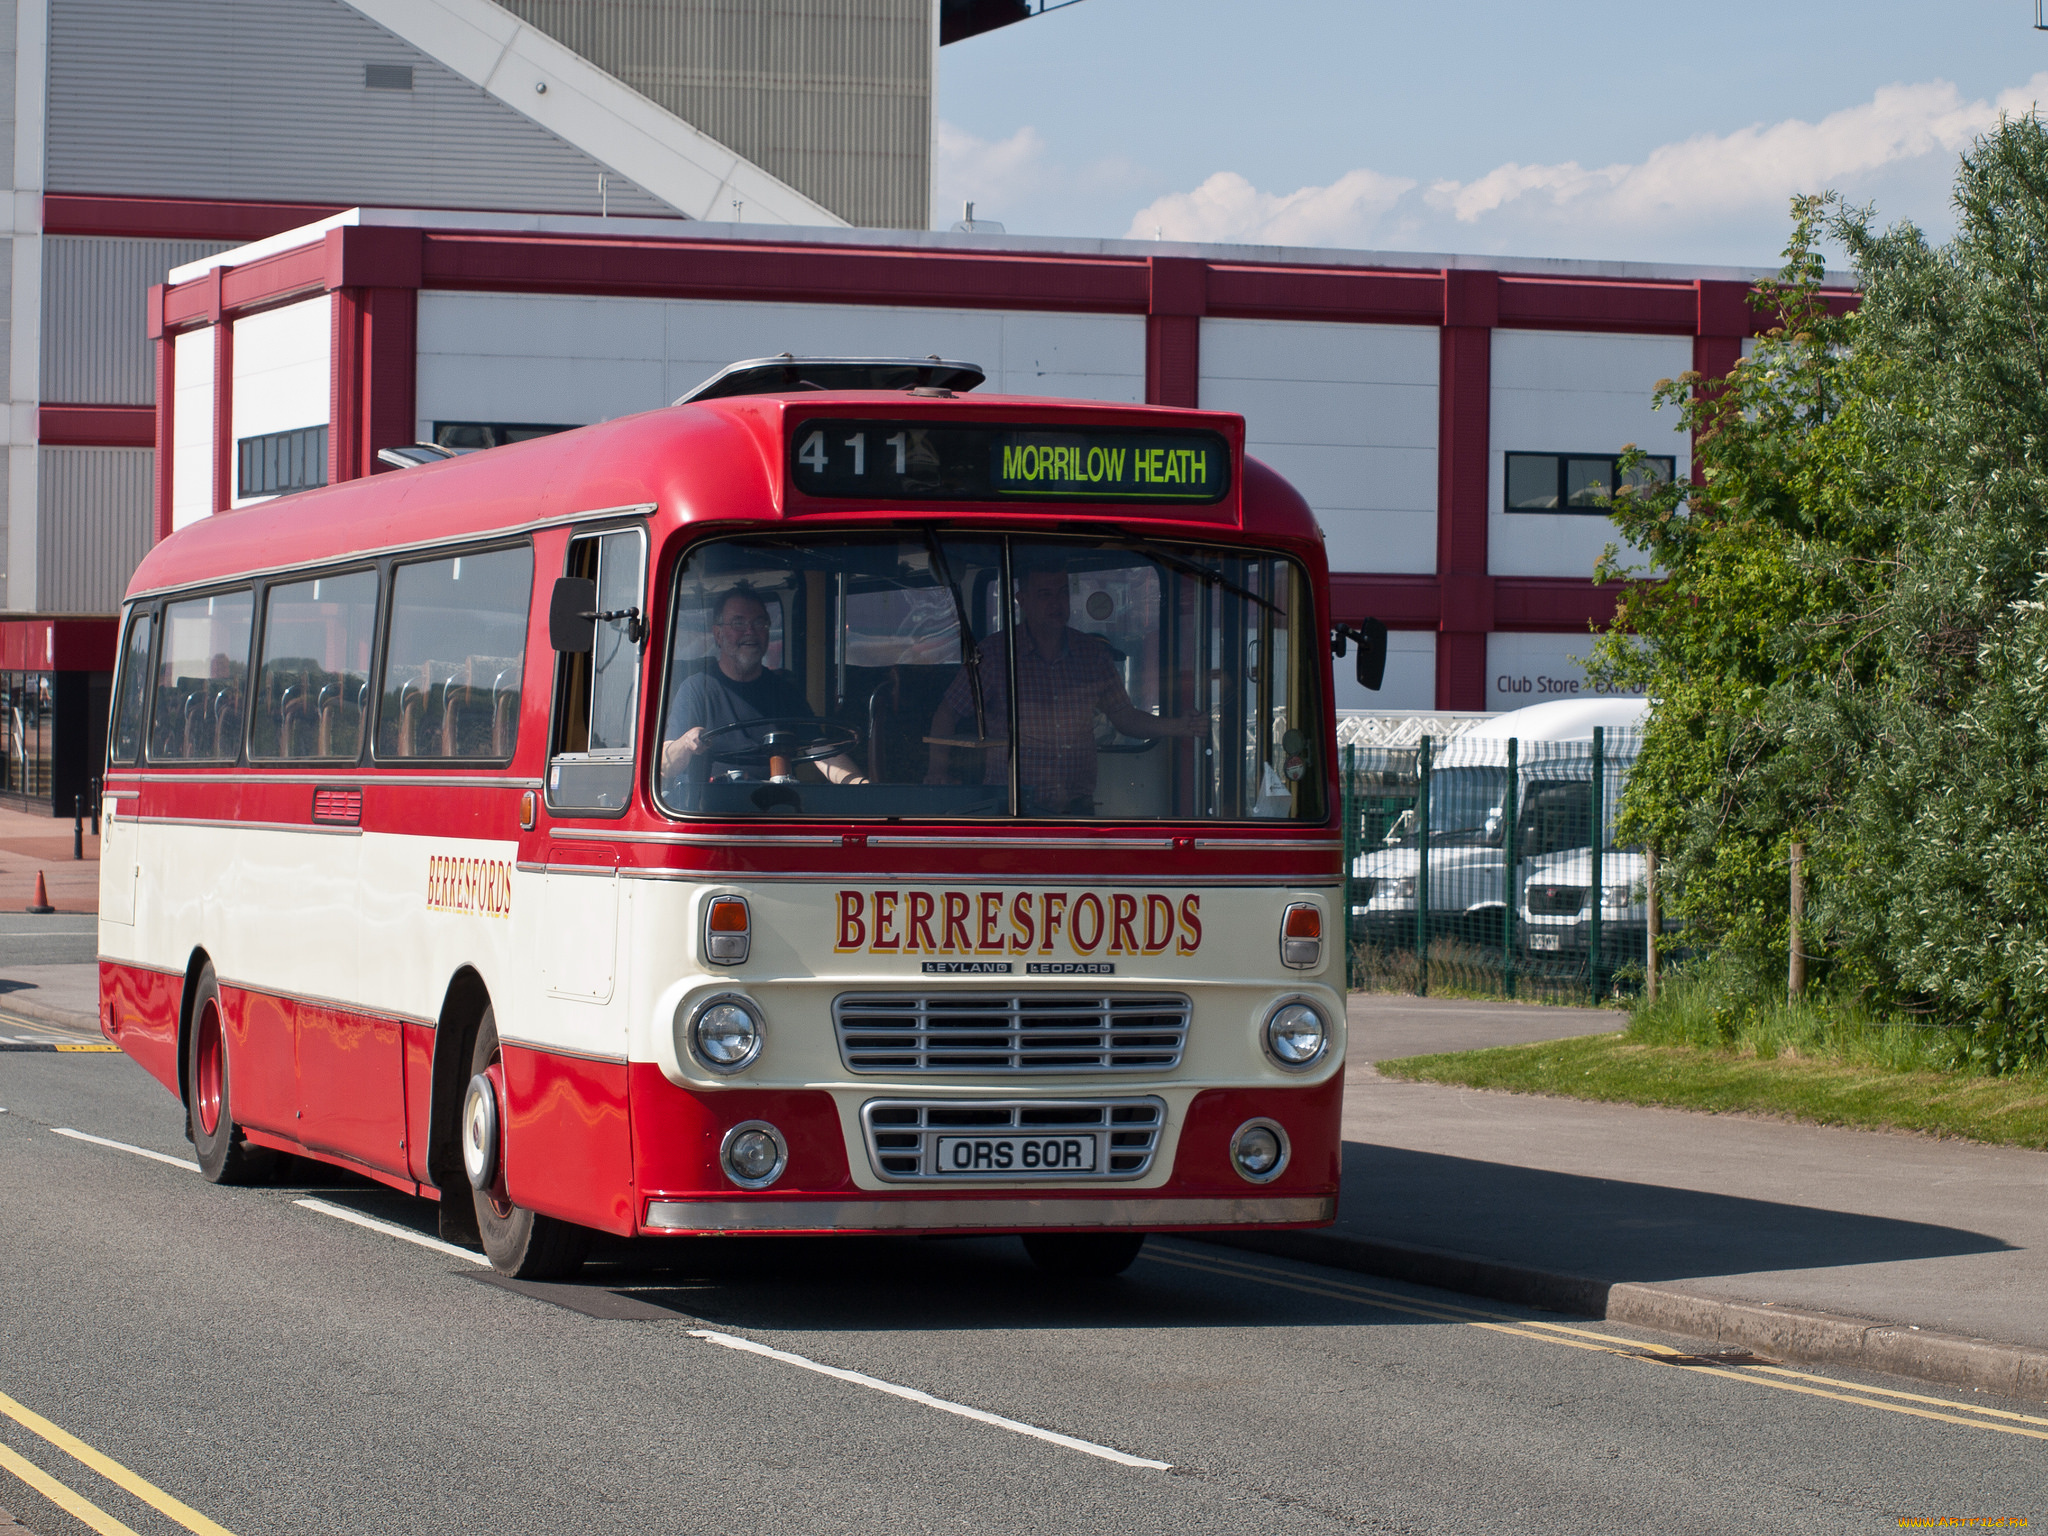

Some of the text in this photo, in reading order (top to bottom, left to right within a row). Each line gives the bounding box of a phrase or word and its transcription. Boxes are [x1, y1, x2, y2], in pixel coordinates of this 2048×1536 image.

[1002, 445, 1126, 482] MORRILOW
[1134, 448, 1207, 484] HEATH
[1496, 675, 1533, 693] Club
[1536, 675, 1579, 693] Store
[427, 855, 512, 919] BERRESFORDS
[834, 890, 1203, 956] BERRESFORDS
[925, 962, 1112, 974] LEYLAND LEOPARD
[952, 1139, 1082, 1169] ORS 60R
